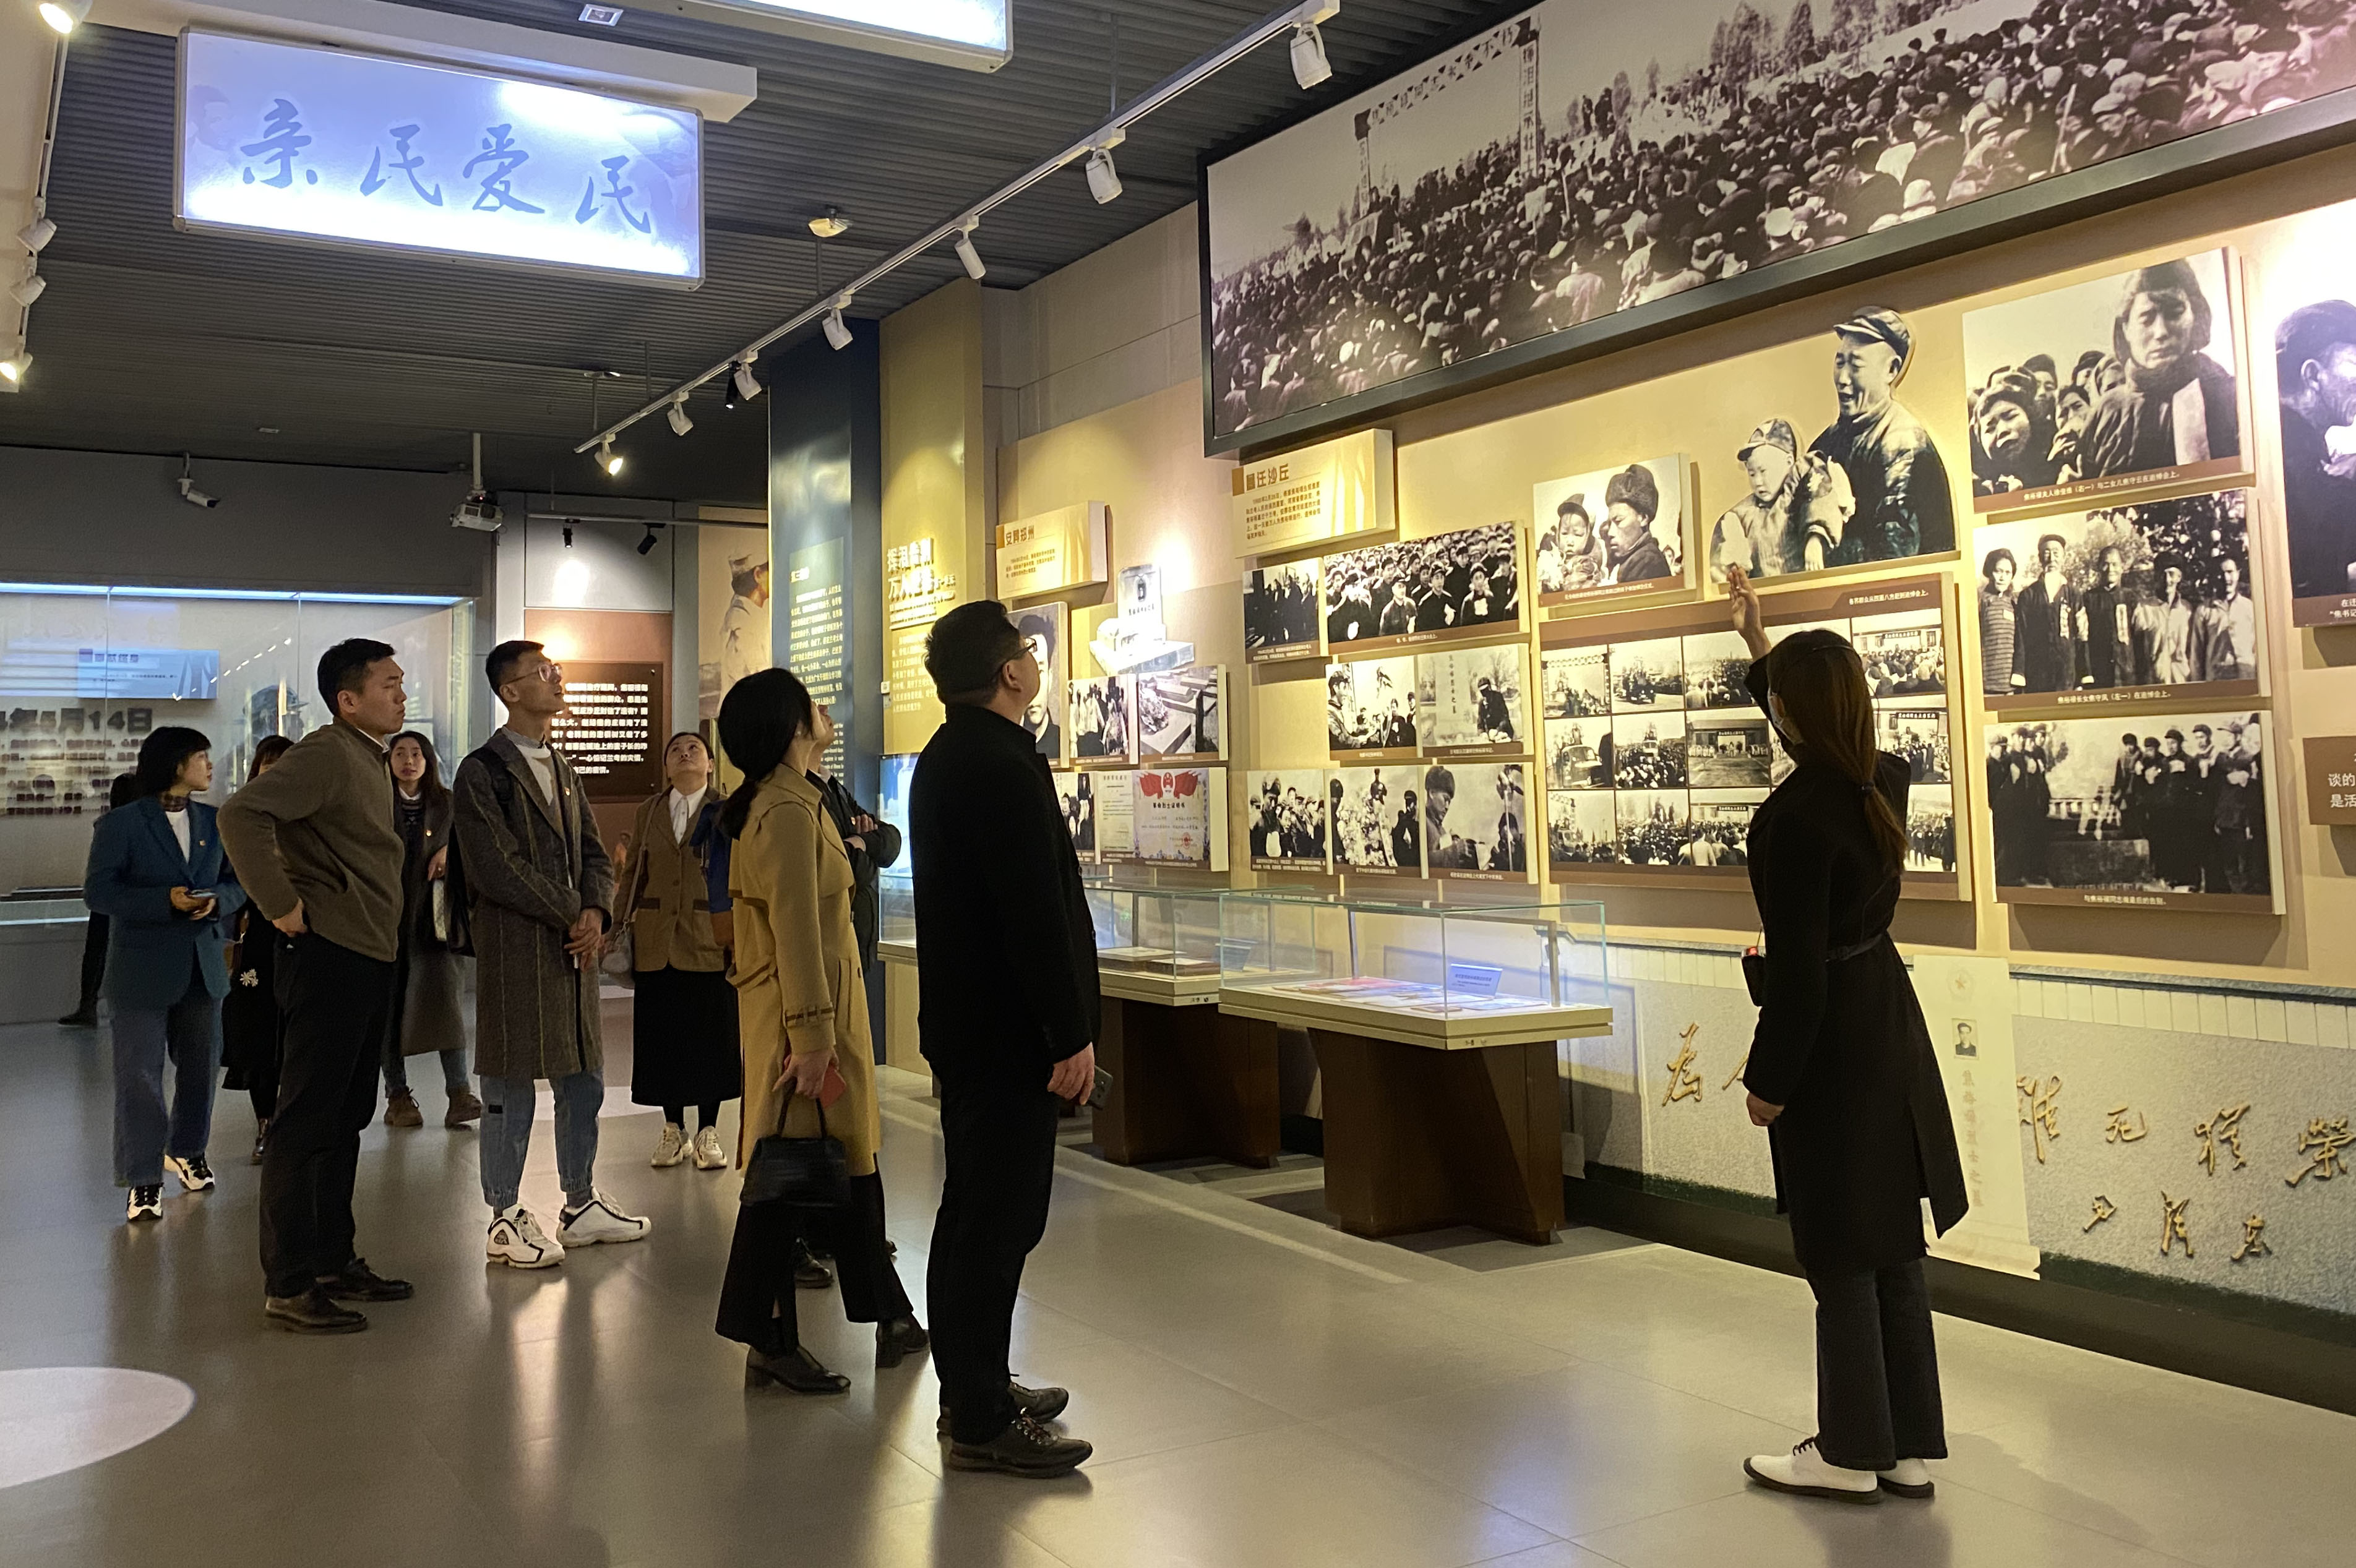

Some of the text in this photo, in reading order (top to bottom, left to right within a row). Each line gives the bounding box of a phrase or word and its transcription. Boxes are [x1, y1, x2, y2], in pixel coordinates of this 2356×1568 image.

[239, 98, 651, 233] 亲民爱民
[1849, 589, 1928, 605] 各界群众从四面八方赶到追悼会上。
[2328, 773, 2355, 787] 谈的
[2331, 794, 2356, 808] 是活
